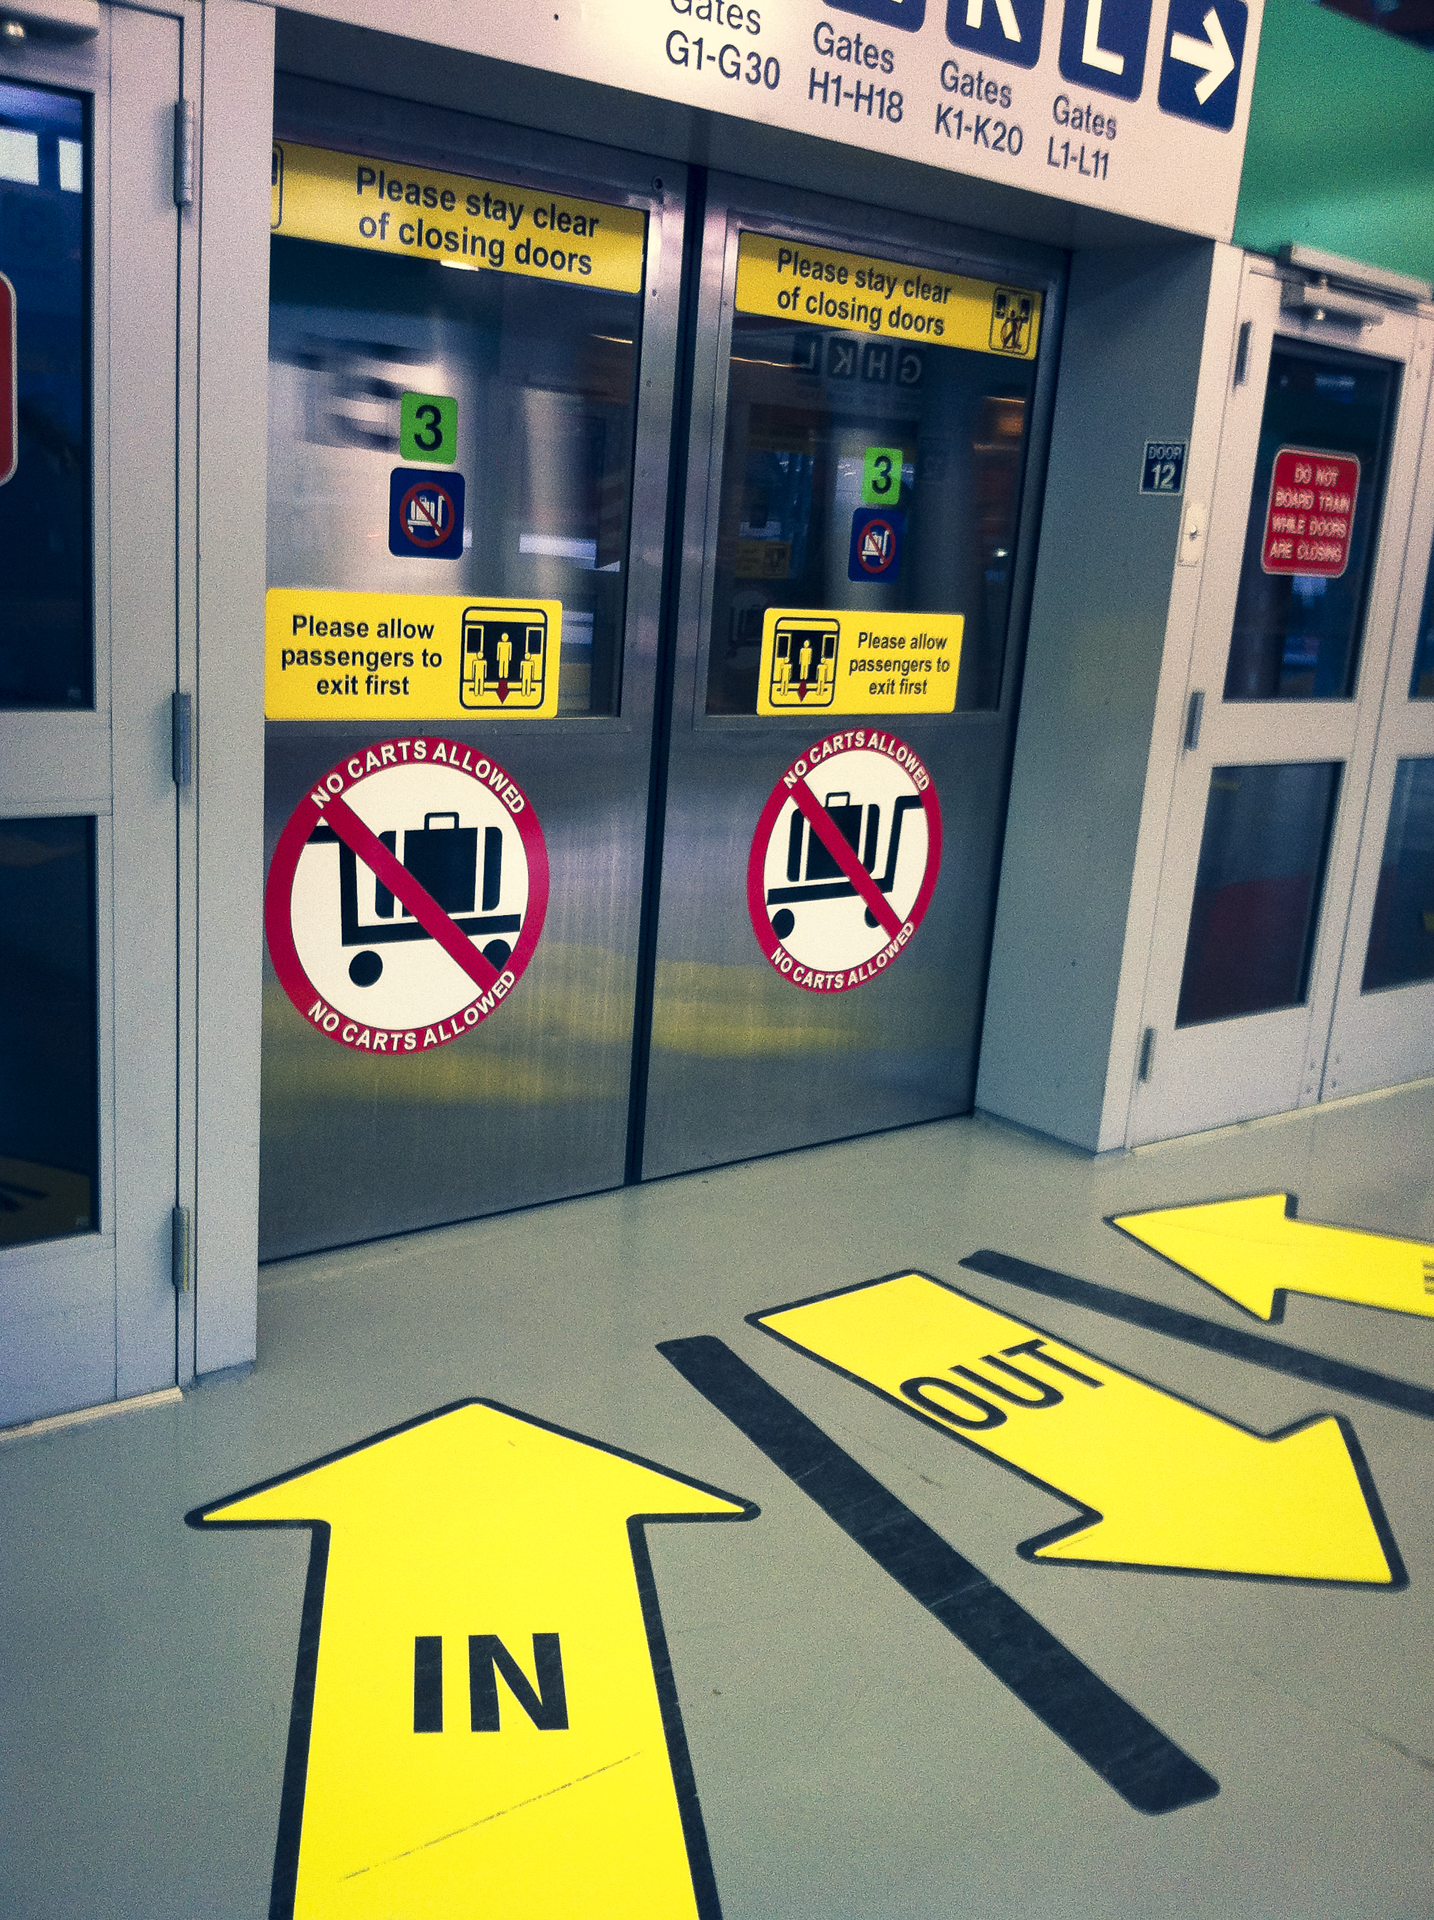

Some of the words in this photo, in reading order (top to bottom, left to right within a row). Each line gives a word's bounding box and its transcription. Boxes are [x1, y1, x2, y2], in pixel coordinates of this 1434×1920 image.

[665, 29, 780, 90] G1-G30
[813, 21, 894, 75] Gates
[808, 67, 903, 123] H1-H18
[940, 59, 1012, 110] Gates
[934, 103, 1024, 157] K1-K20
[1052, 94, 1118, 141] Gates
[1046, 136, 1110, 181] L1-L11
[355, 165, 457, 212] Please
[465, 191, 524, 231] stay
[532, 203, 600, 238] clear
[358, 212, 391, 240] of
[398, 218, 504, 268] closing
[513, 237, 593, 276] doors
[777, 247, 848, 285] Please
[854, 267, 897, 300] stay
[903, 279, 952, 305] clear
[777, 287, 801, 311] of
[805, 291, 882, 332] closing
[888, 305, 945, 337] doors
[413, 404, 444, 452] 3
[870, 455, 893, 496] 3
[1148, 446, 1182, 461] DOOR
[1151, 461, 1177, 490] 12
[1294, 462, 1313, 485] DO
[1315, 464, 1339, 487] NOT
[1274, 486, 1315, 511] BOARD
[1318, 490, 1351, 514] TRAIN
[1271, 512, 1307, 535] WHILE
[1308, 515, 1348, 539] DOORS
[1269, 538, 1293, 559] ARE
[1296, 540, 1343, 563] CLOSING
[292, 614, 369, 638] Please
[376, 618, 435, 639] allow
[857, 631, 905, 649] Please
[910, 633, 948, 650] allow
[281, 648, 414, 672] passengers
[422, 650, 442, 668] to
[849, 657, 932, 676] passengers
[936, 657, 950, 673] to
[316, 675, 358, 695] exit
[365, 675, 410, 695] first
[868, 678, 896, 695] exit
[899, 678, 928, 695] first
[310, 773, 344, 810] NO
[347, 740, 427, 779] CARTS
[431, 741, 526, 815] ALLOWED
[783, 760, 808, 790] NO
[809, 731, 865, 764] CARTS
[867, 731, 930, 792] ALLOWED
[770, 947, 793, 973] NO
[792, 966, 845, 990] CARTS
[847, 921, 915, 987] ALLOWED
[307, 999, 340, 1033] NO
[342, 1023, 418, 1052] CARTS
[423, 970, 516, 1049] ALLOWED
[899, 1338, 1105, 1431] OUT
[413, 1632, 569, 1734] IN
